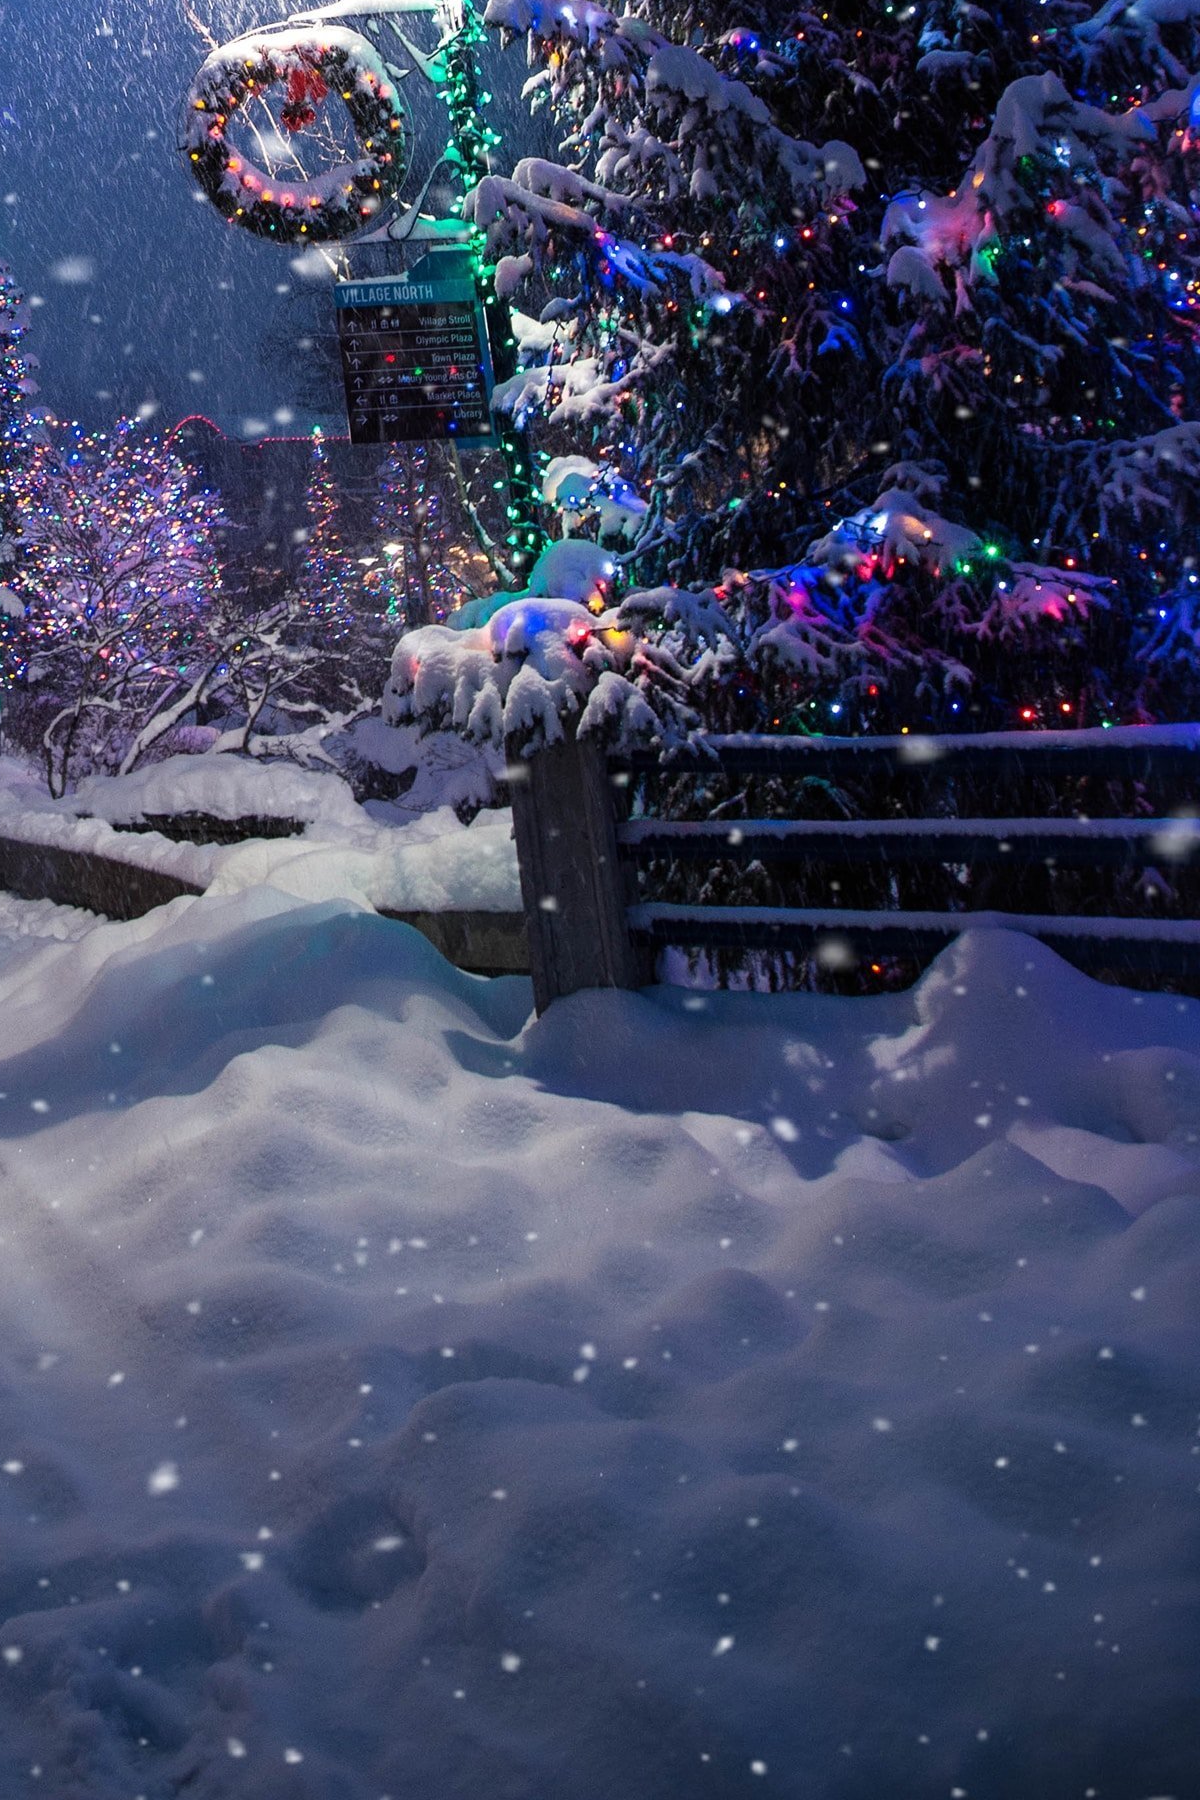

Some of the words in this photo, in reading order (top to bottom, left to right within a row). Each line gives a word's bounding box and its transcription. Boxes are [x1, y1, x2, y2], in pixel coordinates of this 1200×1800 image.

[341, 286, 391, 303] VILLAGE
[393, 284, 434, 300] NORTH
[418, 317, 447, 327] Village
[448, 315, 471, 324] Stroll
[415, 335, 450, 346] Olympic
[450, 333, 473, 342] Plaza
[431, 353, 451, 363] Town
[453, 352, 475, 361] Plaza
[423, 373, 448, 382] Young
[427, 391, 456, 401] Market
[457, 390, 480, 398] Place
[453, 409, 483, 419] Library
